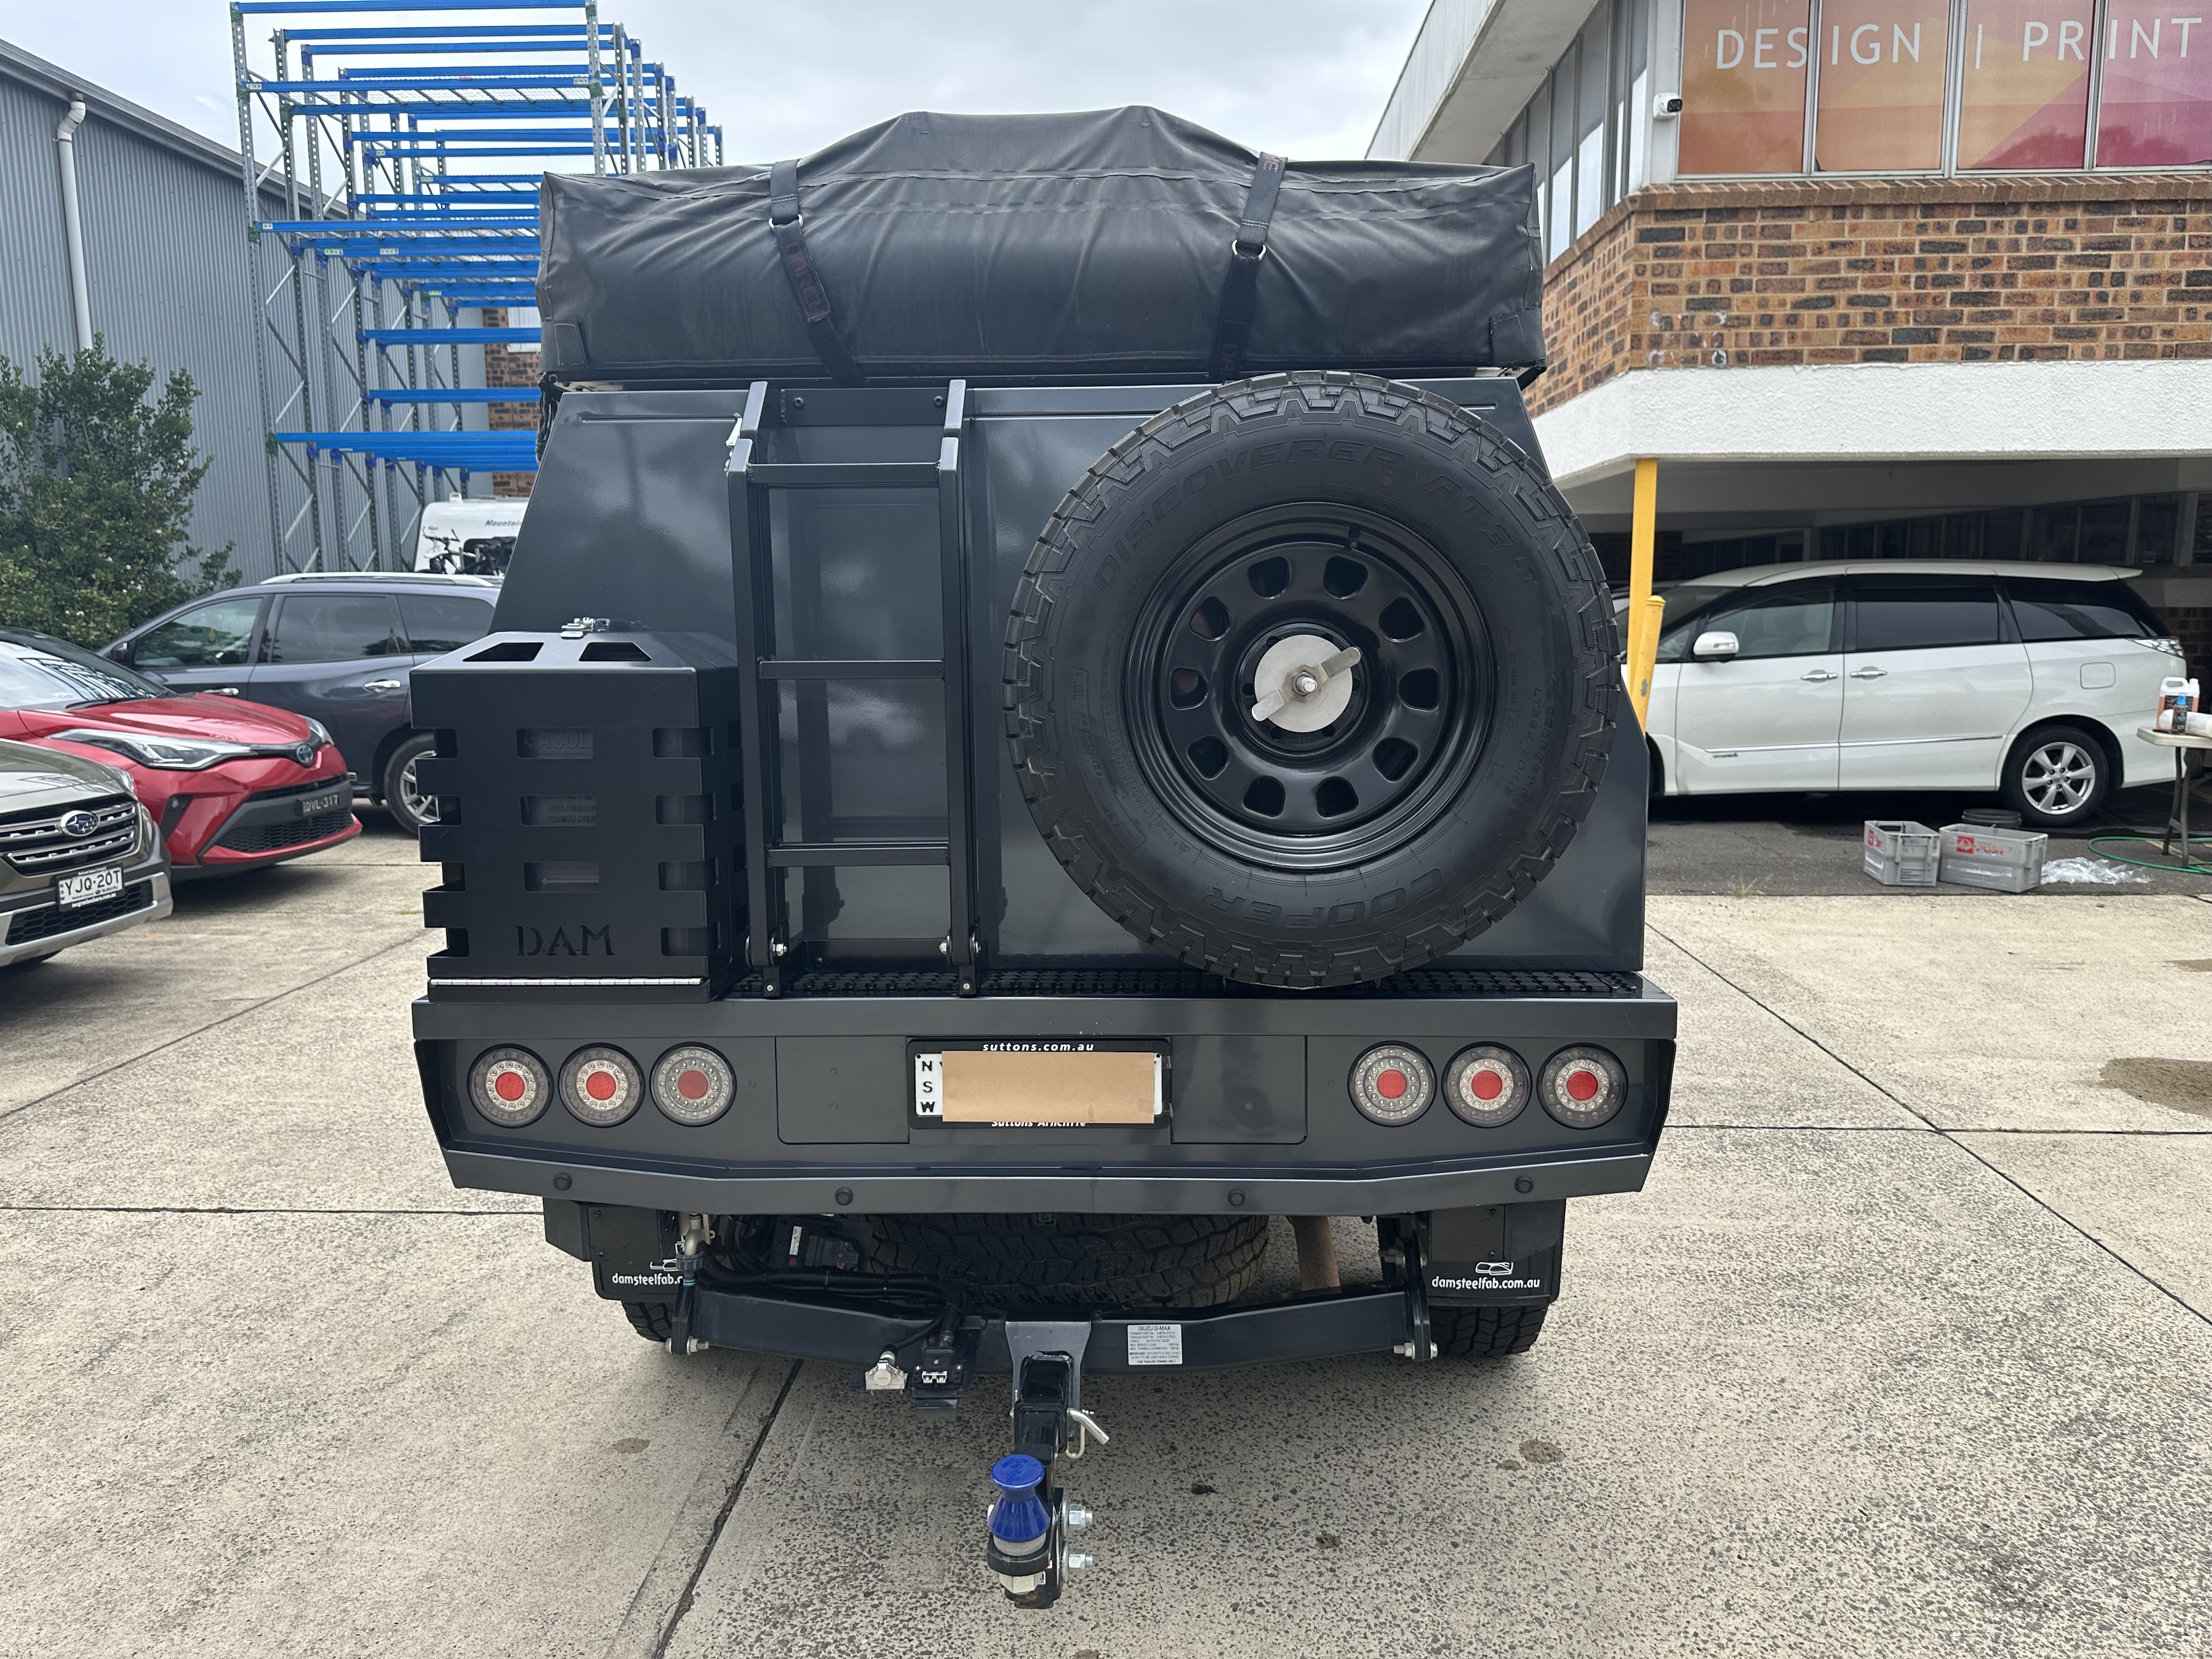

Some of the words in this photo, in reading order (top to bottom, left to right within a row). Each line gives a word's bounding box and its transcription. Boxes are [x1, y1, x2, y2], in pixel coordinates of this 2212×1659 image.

[1717, 22, 1921, 70] DESIGN
[2022, 17, 2202, 61] PRINT
[1093, 436, 1406, 591] DISCOVERER
[1201, 867, 1446, 930] COOPER
[983, 1041, 1094, 1051] suttons.com.au
[1431, 1276, 1541, 1290] damsteelfab.com.au
